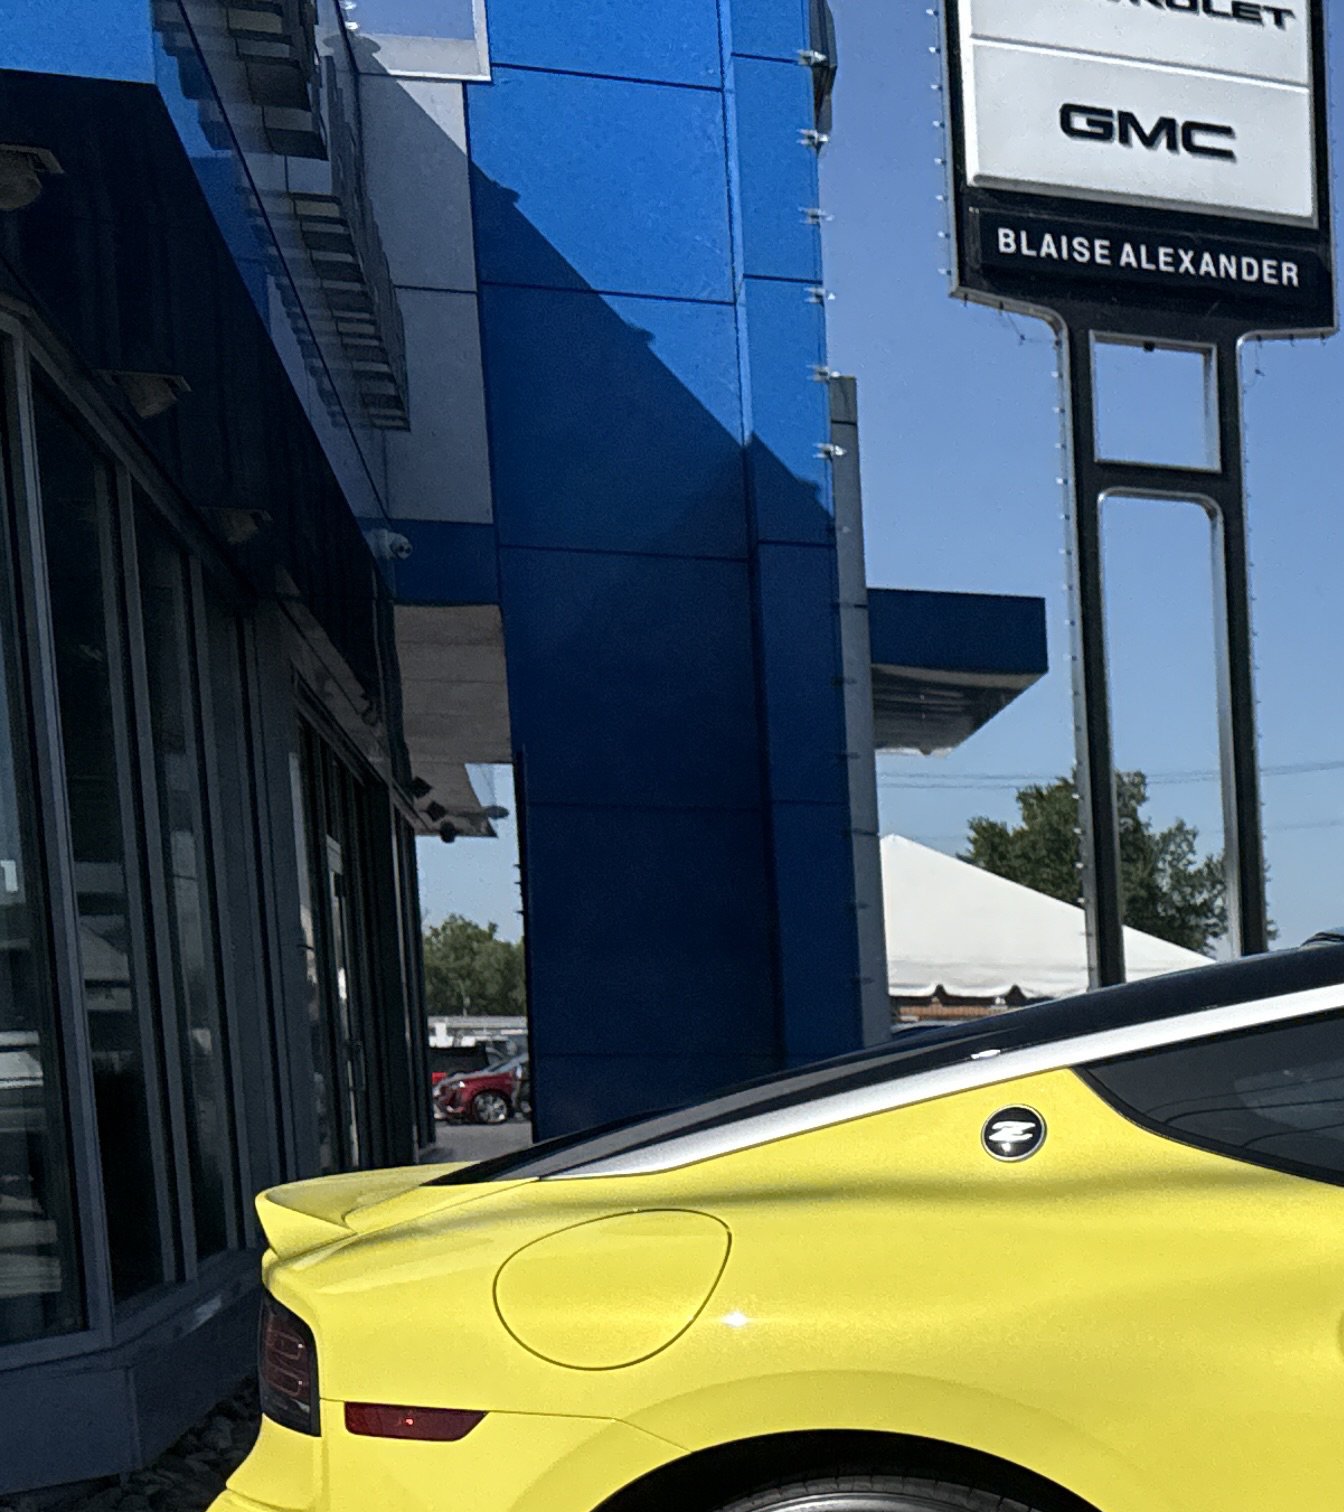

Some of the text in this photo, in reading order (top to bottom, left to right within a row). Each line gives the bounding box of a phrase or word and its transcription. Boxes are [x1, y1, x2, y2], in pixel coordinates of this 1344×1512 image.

[1059, 102, 1237, 161] GMC
[997, 227, 1300, 288] BLAISE ALEXANDER
